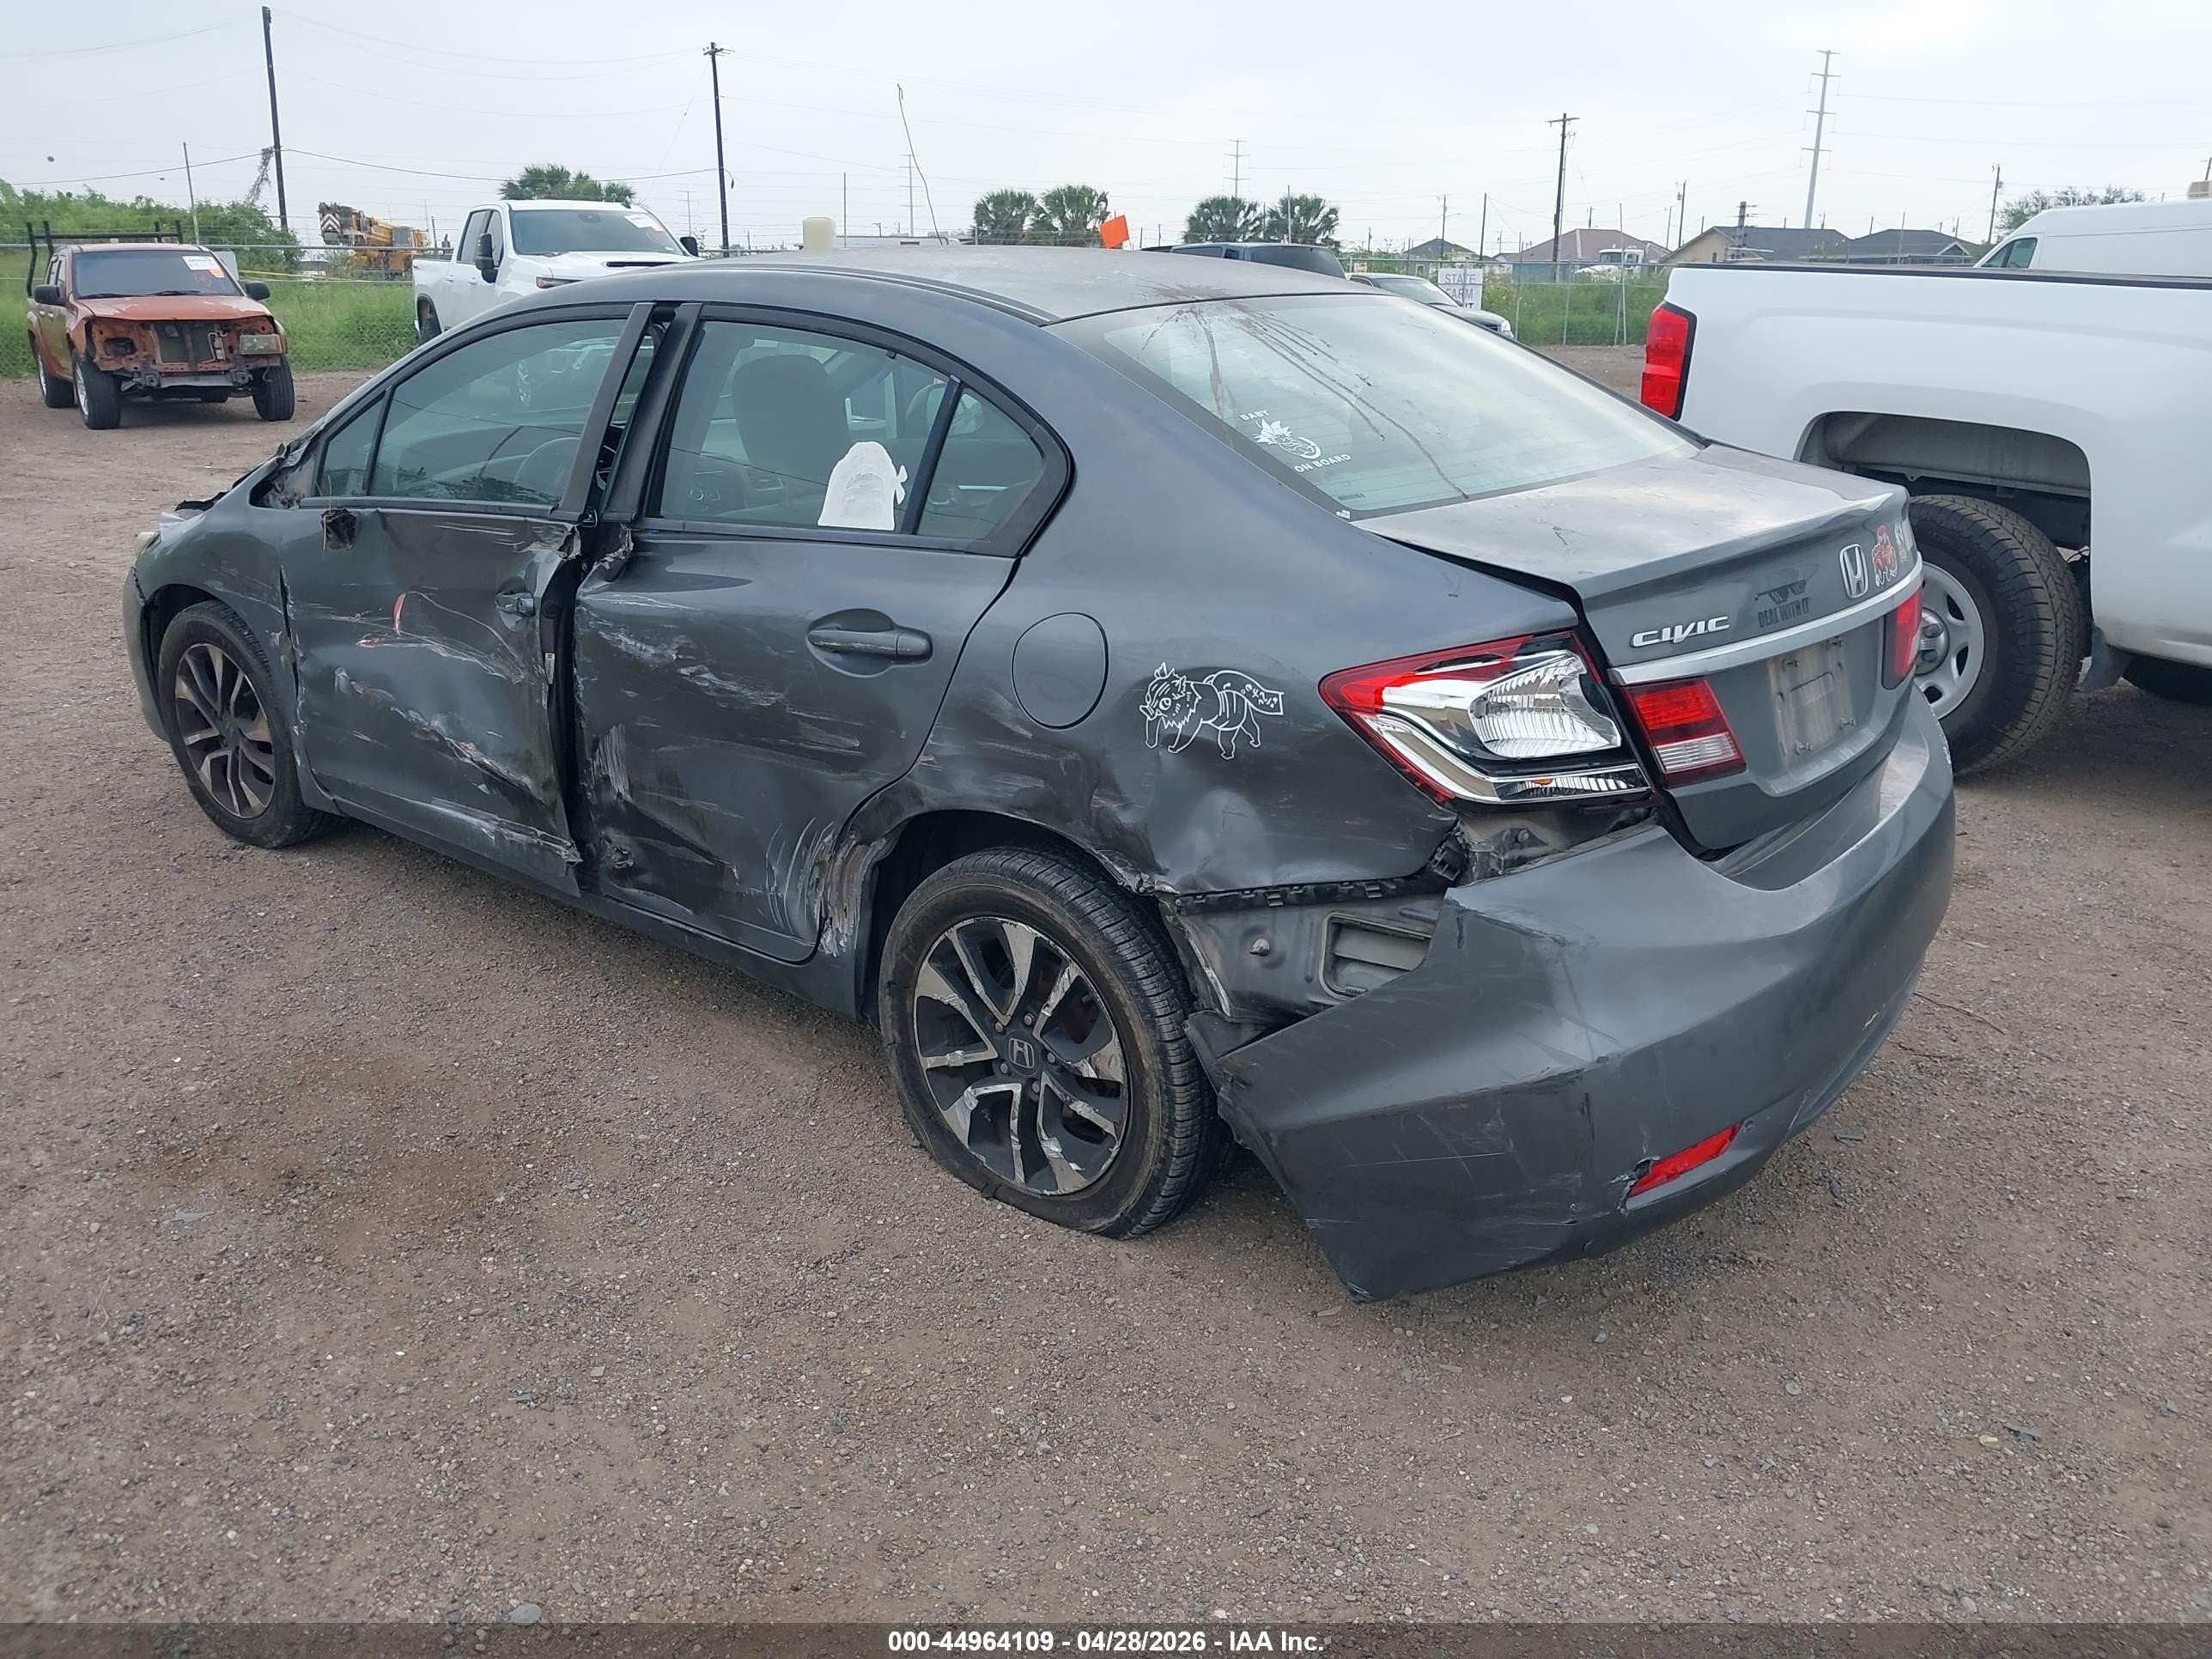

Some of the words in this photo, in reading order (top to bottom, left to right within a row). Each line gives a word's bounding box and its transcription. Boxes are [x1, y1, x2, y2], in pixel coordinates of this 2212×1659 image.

[1445, 274, 1475, 284] STATE
[1239, 409, 1271, 422] BABY
[1294, 463, 1314, 473] ON
[1313, 453, 1352, 469] BOARD
[1758, 606, 1780, 629] DEAL
[1779, 600, 1802, 623] WITH
[1630, 615, 1731, 648] CIVIC
